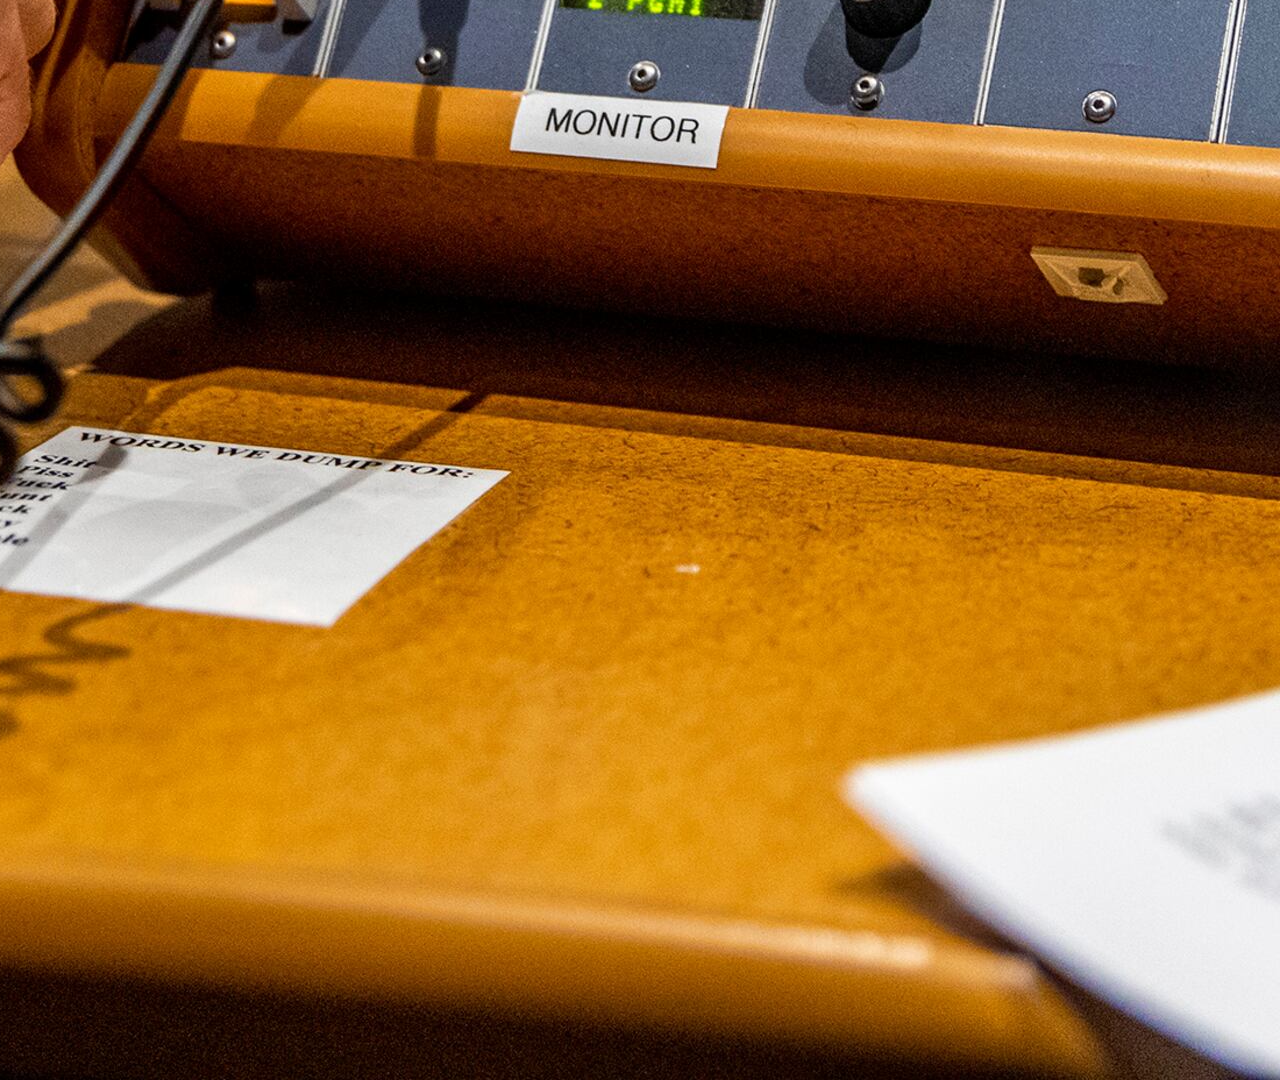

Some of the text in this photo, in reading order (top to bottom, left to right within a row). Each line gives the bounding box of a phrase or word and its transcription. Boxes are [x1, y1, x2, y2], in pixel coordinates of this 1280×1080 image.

[545, 106, 700, 144] MONITOR
[33, 453, 99, 469] Shit
[79, 430, 475, 480] WORDS WE DUMP FOR:
